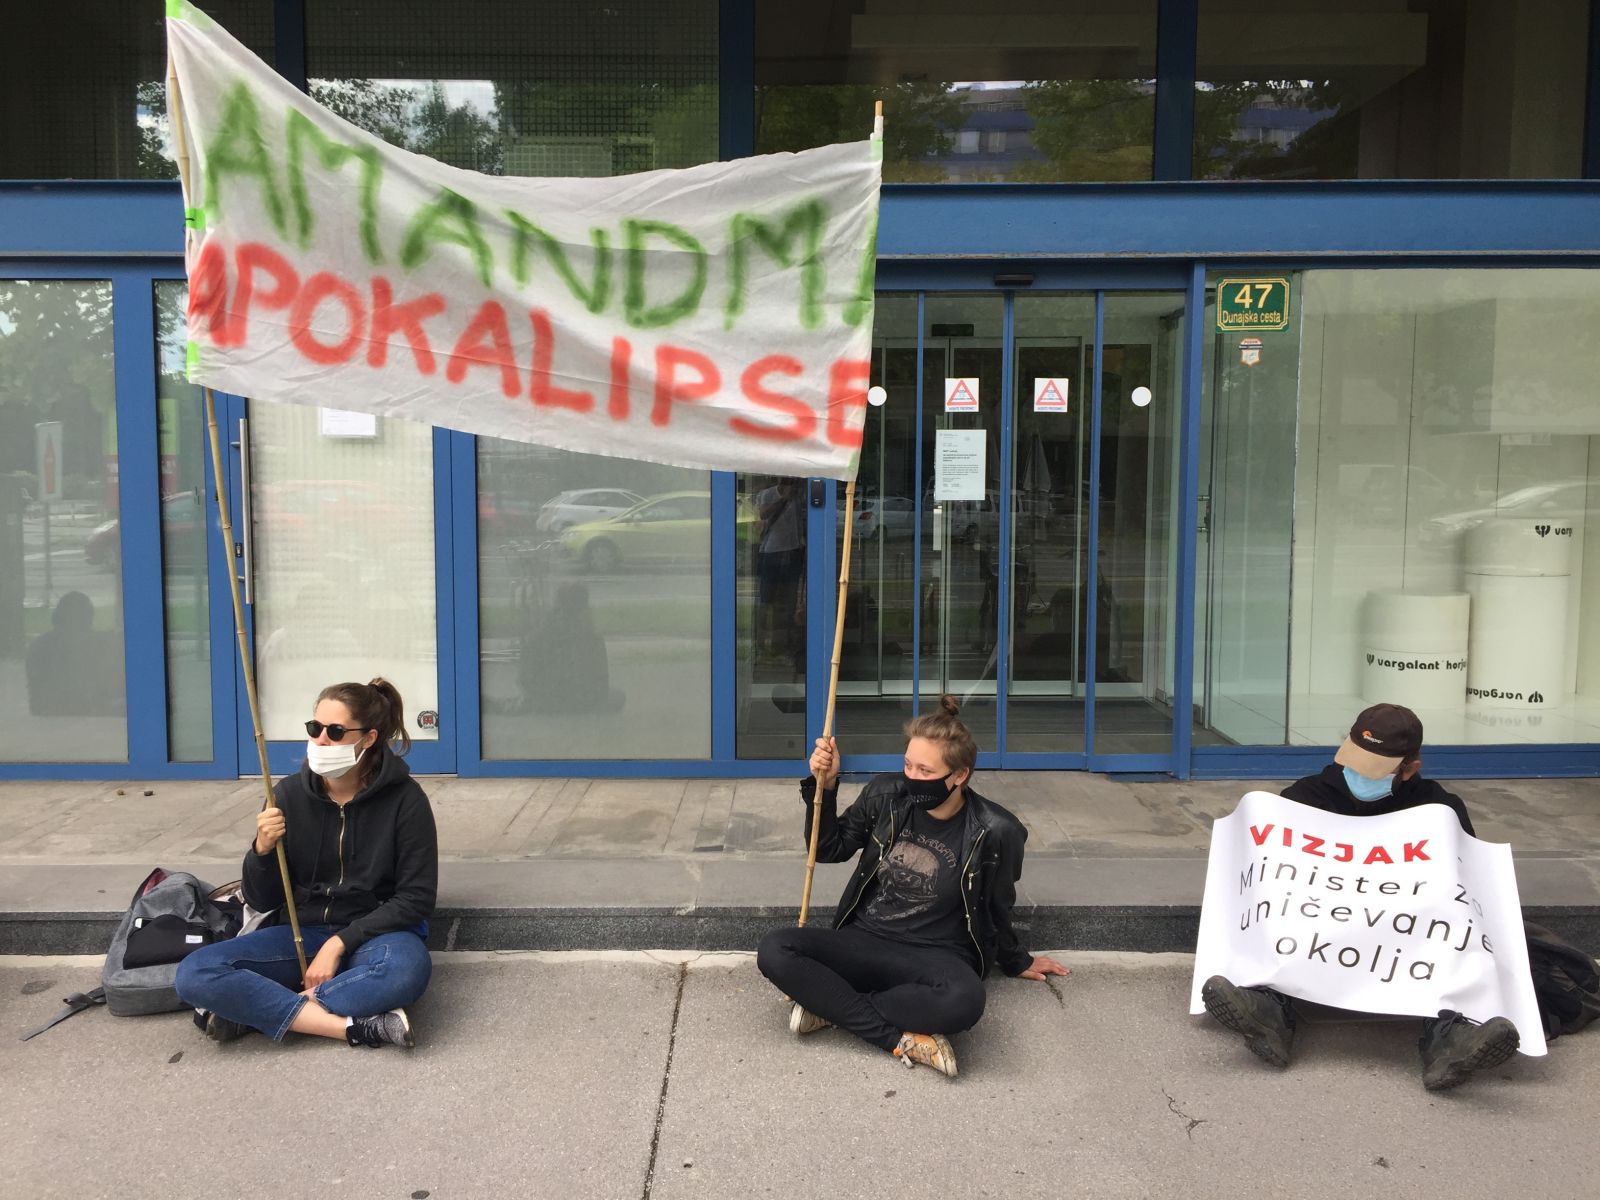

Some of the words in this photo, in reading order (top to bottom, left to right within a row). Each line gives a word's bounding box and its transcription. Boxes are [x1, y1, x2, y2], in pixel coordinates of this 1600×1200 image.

[1234, 284, 1273, 309] 47
[1222, 310, 1258, 326] Dunajska
[1260, 310, 1281, 323] cesta
[187, 241, 870, 448] APOKALIPSE
[1250, 823, 1431, 865] VIZJAK
[1240, 856, 1427, 896] Minister
[1240, 892, 1494, 954] uničevanje
[1275, 933, 1435, 983] okolja
